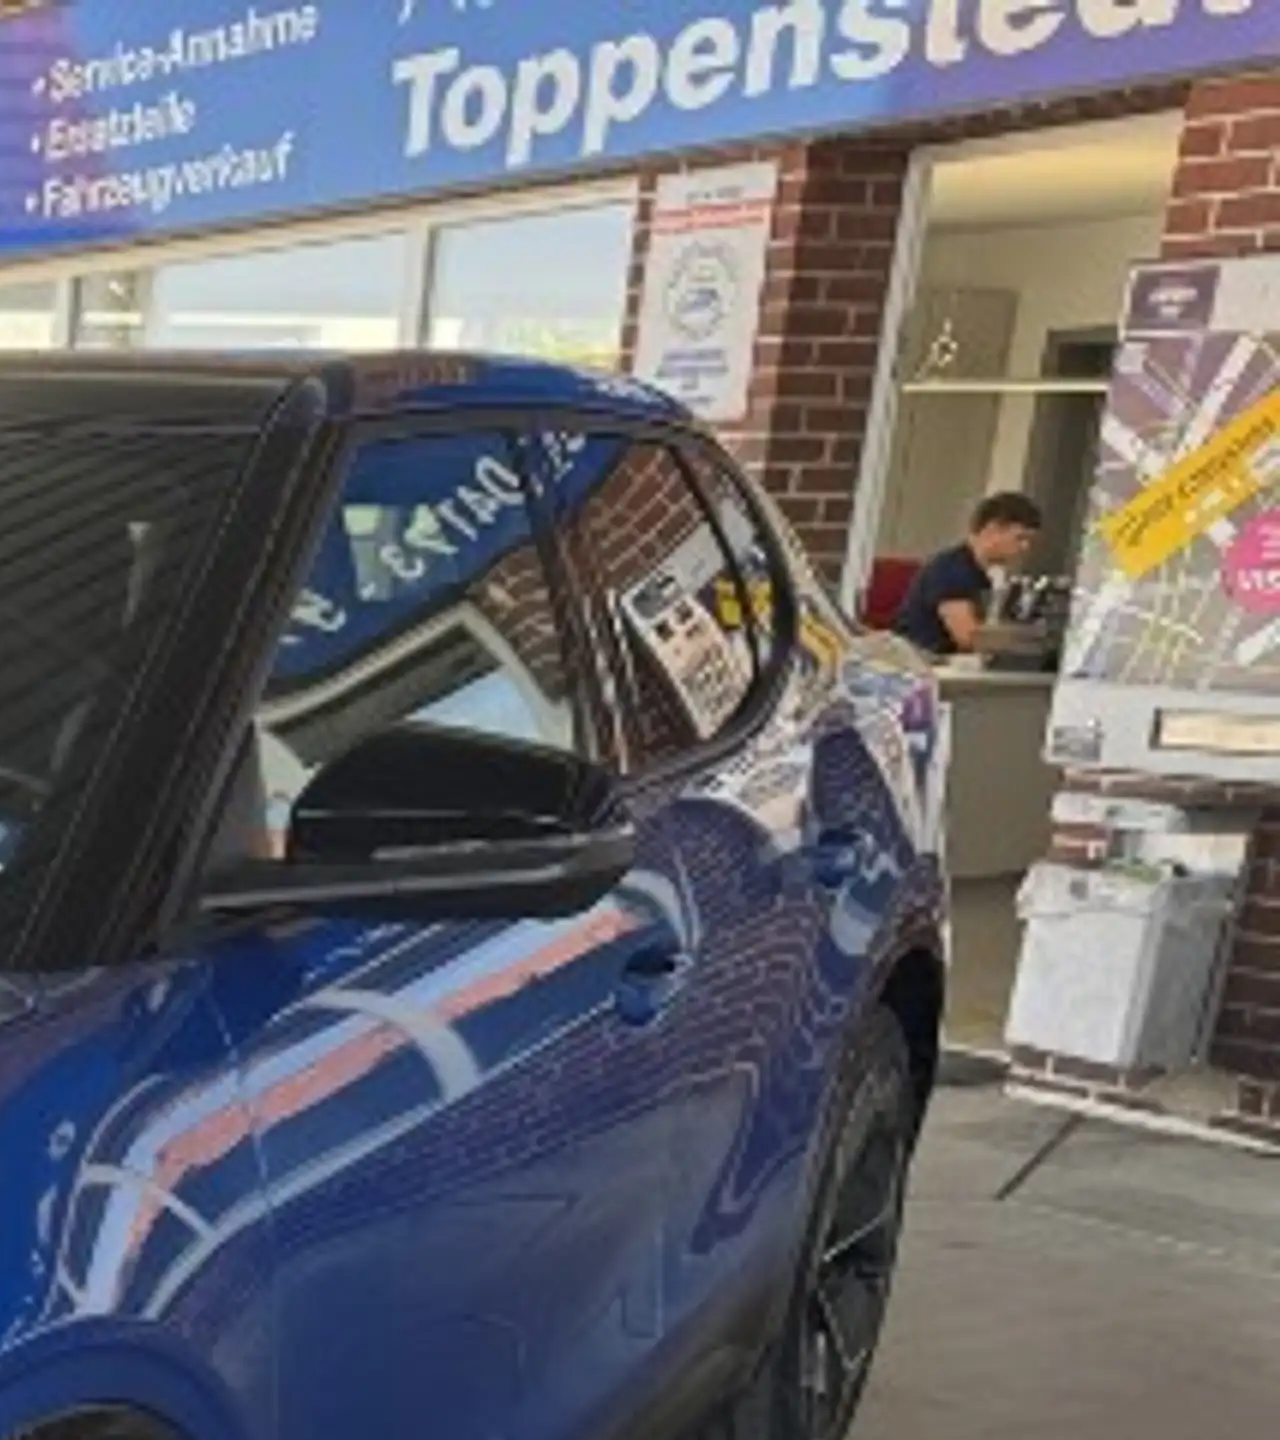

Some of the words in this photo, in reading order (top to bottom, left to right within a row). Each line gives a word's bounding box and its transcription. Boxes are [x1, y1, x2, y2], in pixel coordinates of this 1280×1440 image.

[48, 4, 318, 102] Service-Annahme
[393, 0, 1253, 166] Toppenste
[42, 129, 295, 220] Fahrzeugverkauf
